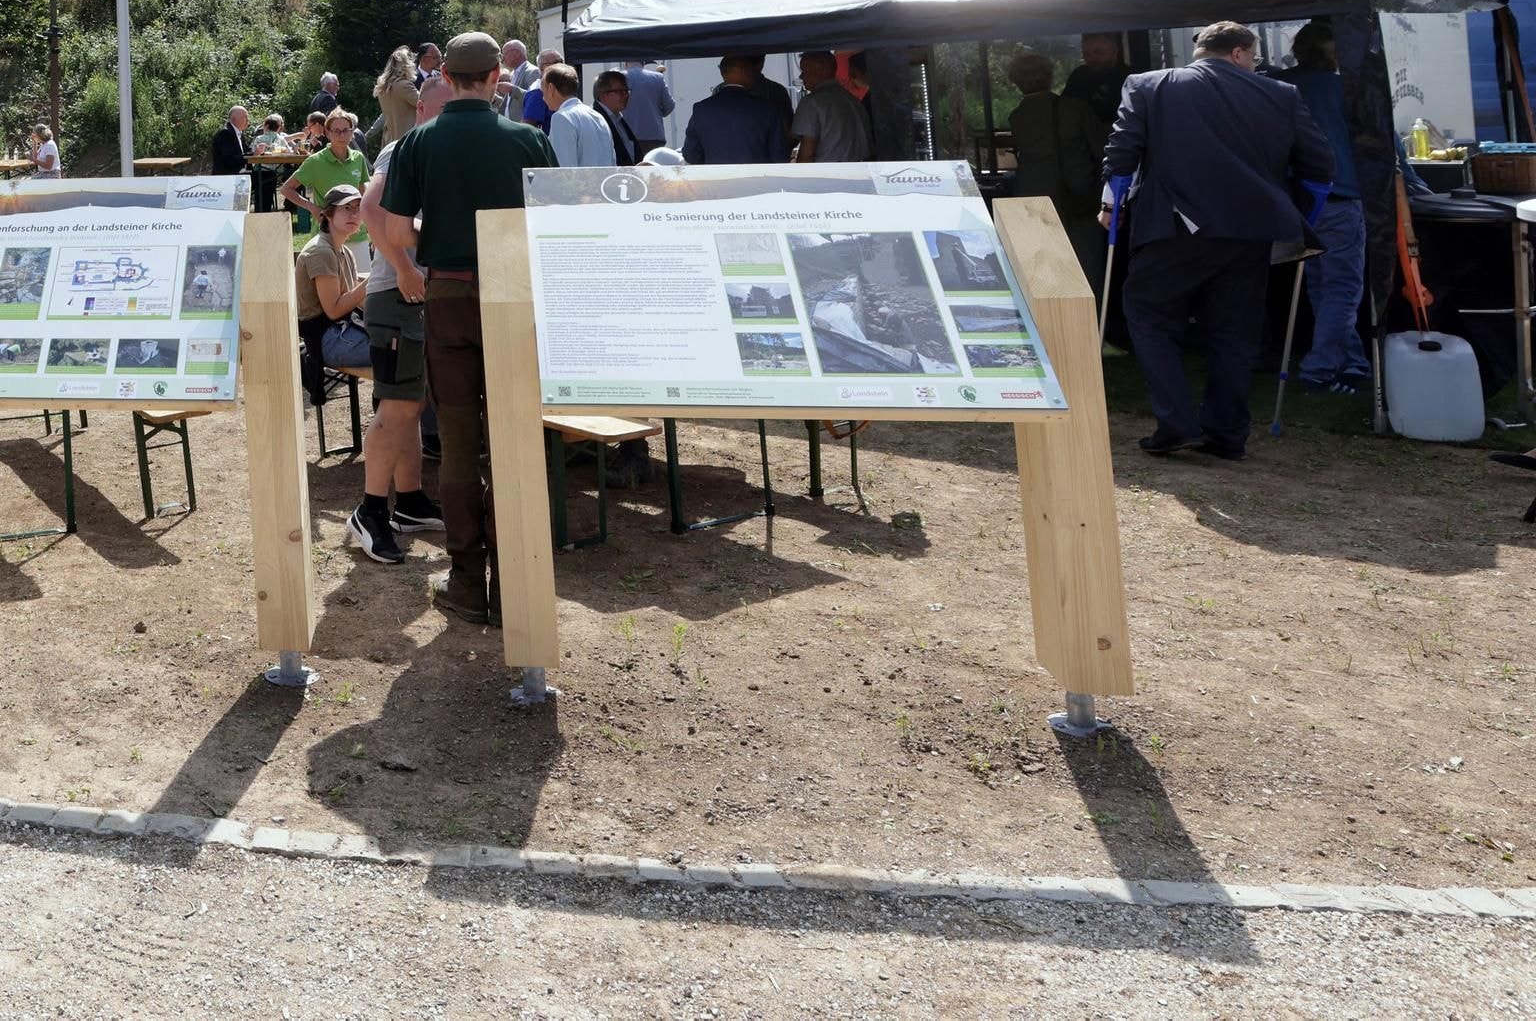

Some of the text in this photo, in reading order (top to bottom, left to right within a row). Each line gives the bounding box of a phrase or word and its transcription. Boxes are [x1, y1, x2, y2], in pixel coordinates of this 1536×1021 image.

[880, 173, 942, 184] Taunus
[174, 189, 222, 199] Taunus
[643, 210, 863, 223] Die Sanierung der Landsteiner Kirche
[72, 223, 88, 232] der
[91, 222, 149, 232] Landsteiner
[151, 222, 183, 231] Kirche
